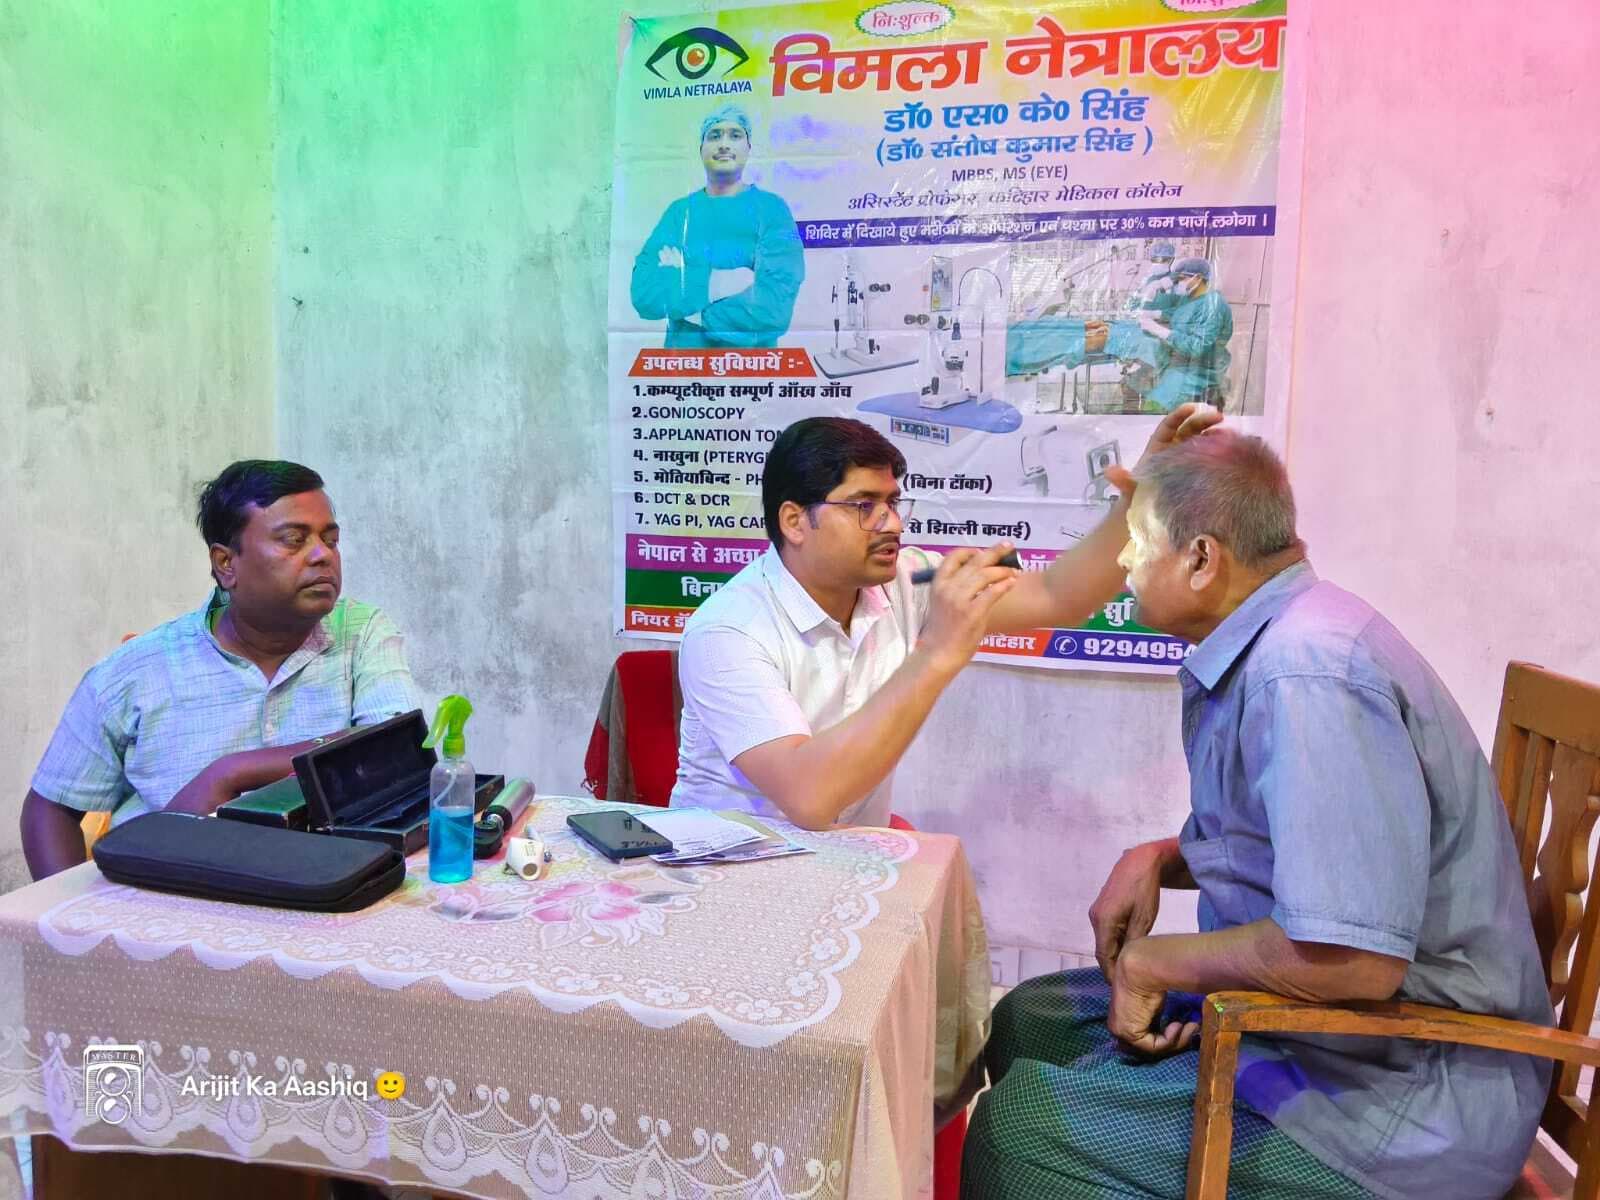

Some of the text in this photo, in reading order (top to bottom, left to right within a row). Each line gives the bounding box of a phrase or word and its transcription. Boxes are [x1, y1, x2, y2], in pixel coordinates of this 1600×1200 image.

[769, 16, 1286, 97] विमला नेत्रालय
[643, 80, 752, 101] VIMLA NETRALAYA
[1080, 89, 1149, 121] सिंह
[930, 133, 998, 159] संतोष
[1004, 133, 1078, 162] कुमार
[1084, 126, 1136, 153] सिंह
[951, 164, 1069, 183] MBBS, MS (EYE)
[1055, 184, 1119, 202] मेडिकल
[1126, 180, 1184, 199] कॉलेज
[805, 223, 840, 241] शिविर
[842, 223, 853, 240] में
[855, 222, 895, 240] दिखाये
[899, 224, 917, 242] हुए
[1100, 219, 1118, 231] पर
[1121, 217, 1145, 230] 30%
[1148, 214, 1175, 228] कम
[1178, 211, 1210, 229] चार्ज
[1212, 211, 1258, 228] लगेगा
[642, 356, 705, 371] उपलब्ध
[708, 351, 784, 376] सुविधायें
[729, 382, 773, 402] सम्पूर्ण
[633, 449, 649, 461] 4.
[653, 450, 700, 466] नाखुना
[633, 470, 649, 483] 5.
[653, 468, 731, 486] मोतियाबिन्द
[634, 492, 730, 507] 6. DCT & DCR
[634, 512, 650, 525] 7.
[654, 513, 681, 526] YAG
[685, 514, 703, 529] PI,
[707, 516, 735, 530] YAG
[908, 518, 1032, 541] से झिल्ली कटाई)
[637, 539, 687, 563] नेपाल
[691, 541, 707, 563] से
[631, 610, 669, 627] नियर
